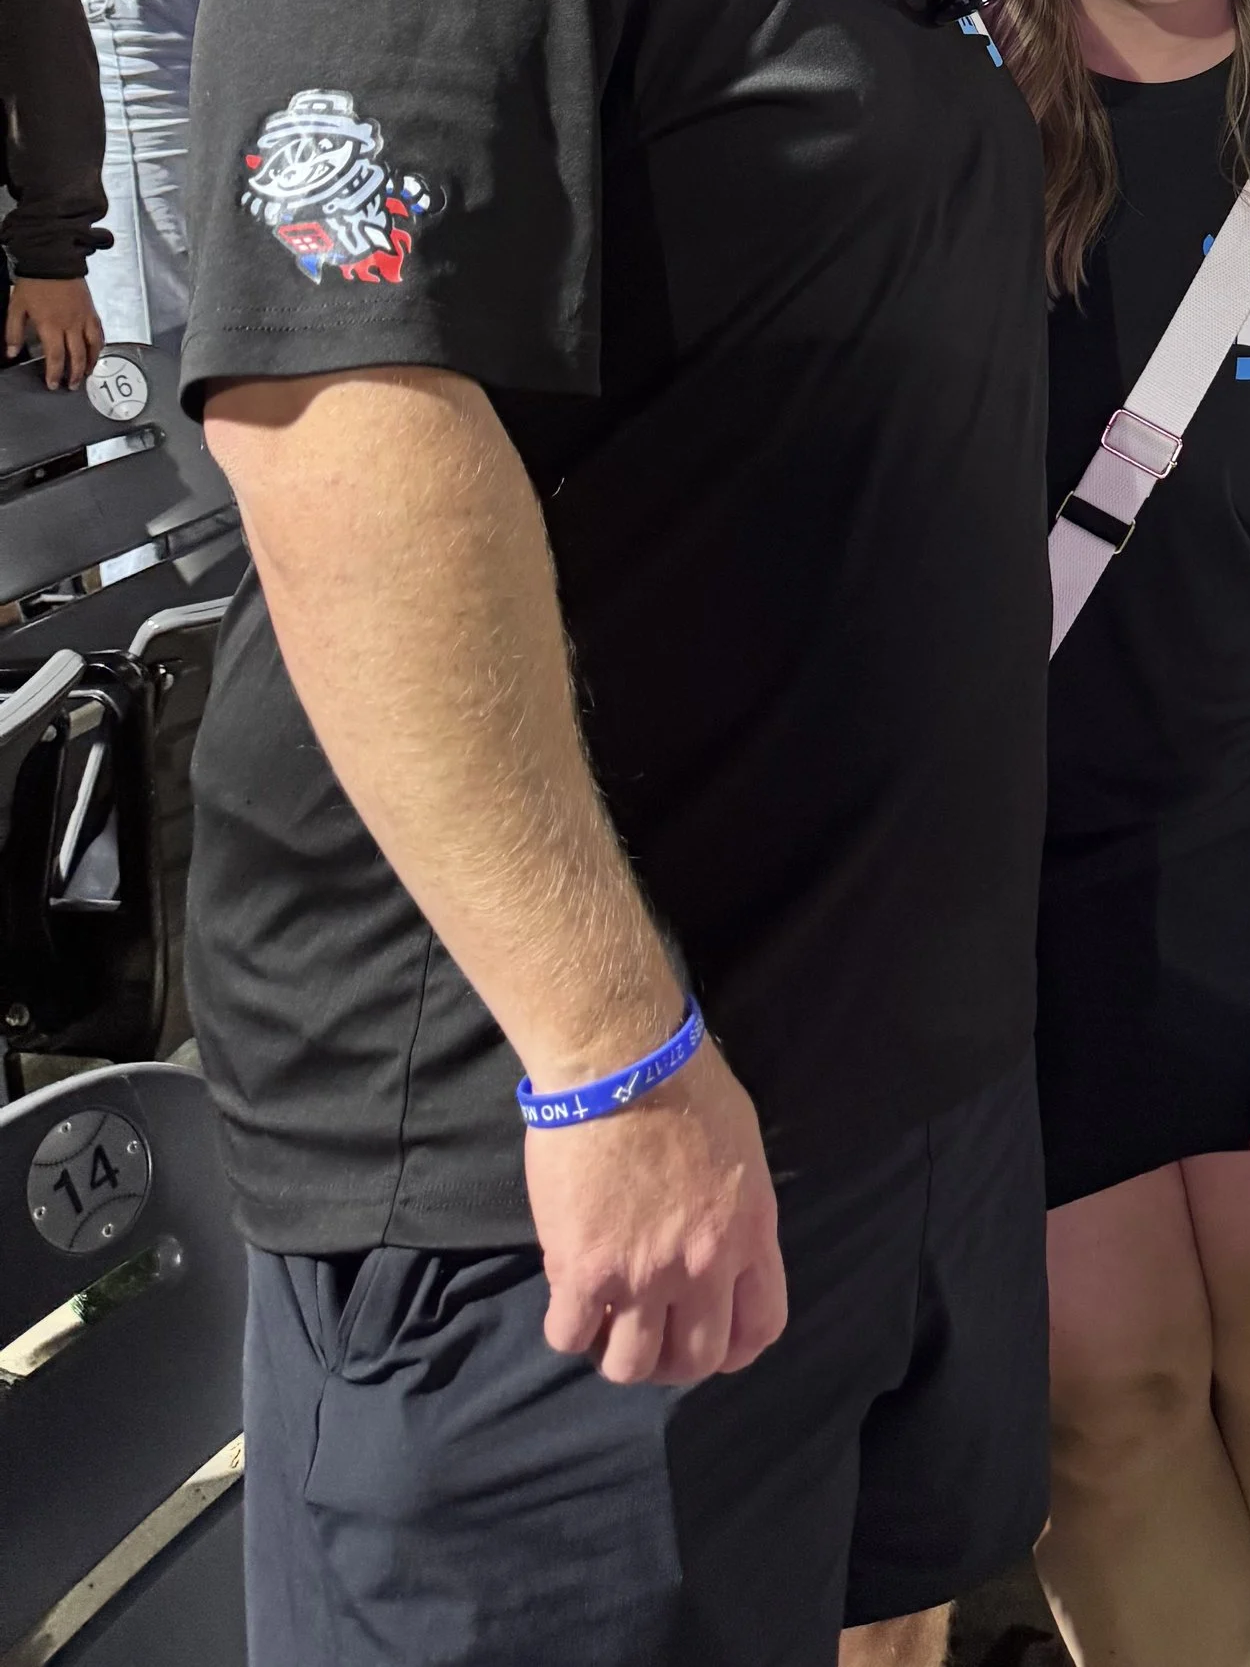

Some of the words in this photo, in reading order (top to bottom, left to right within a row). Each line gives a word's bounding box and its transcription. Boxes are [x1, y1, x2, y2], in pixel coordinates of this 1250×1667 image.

[99, 374, 133, 403] 16
[541, 1102, 569, 1122] NO
[53, 1143, 120, 1215] 14
